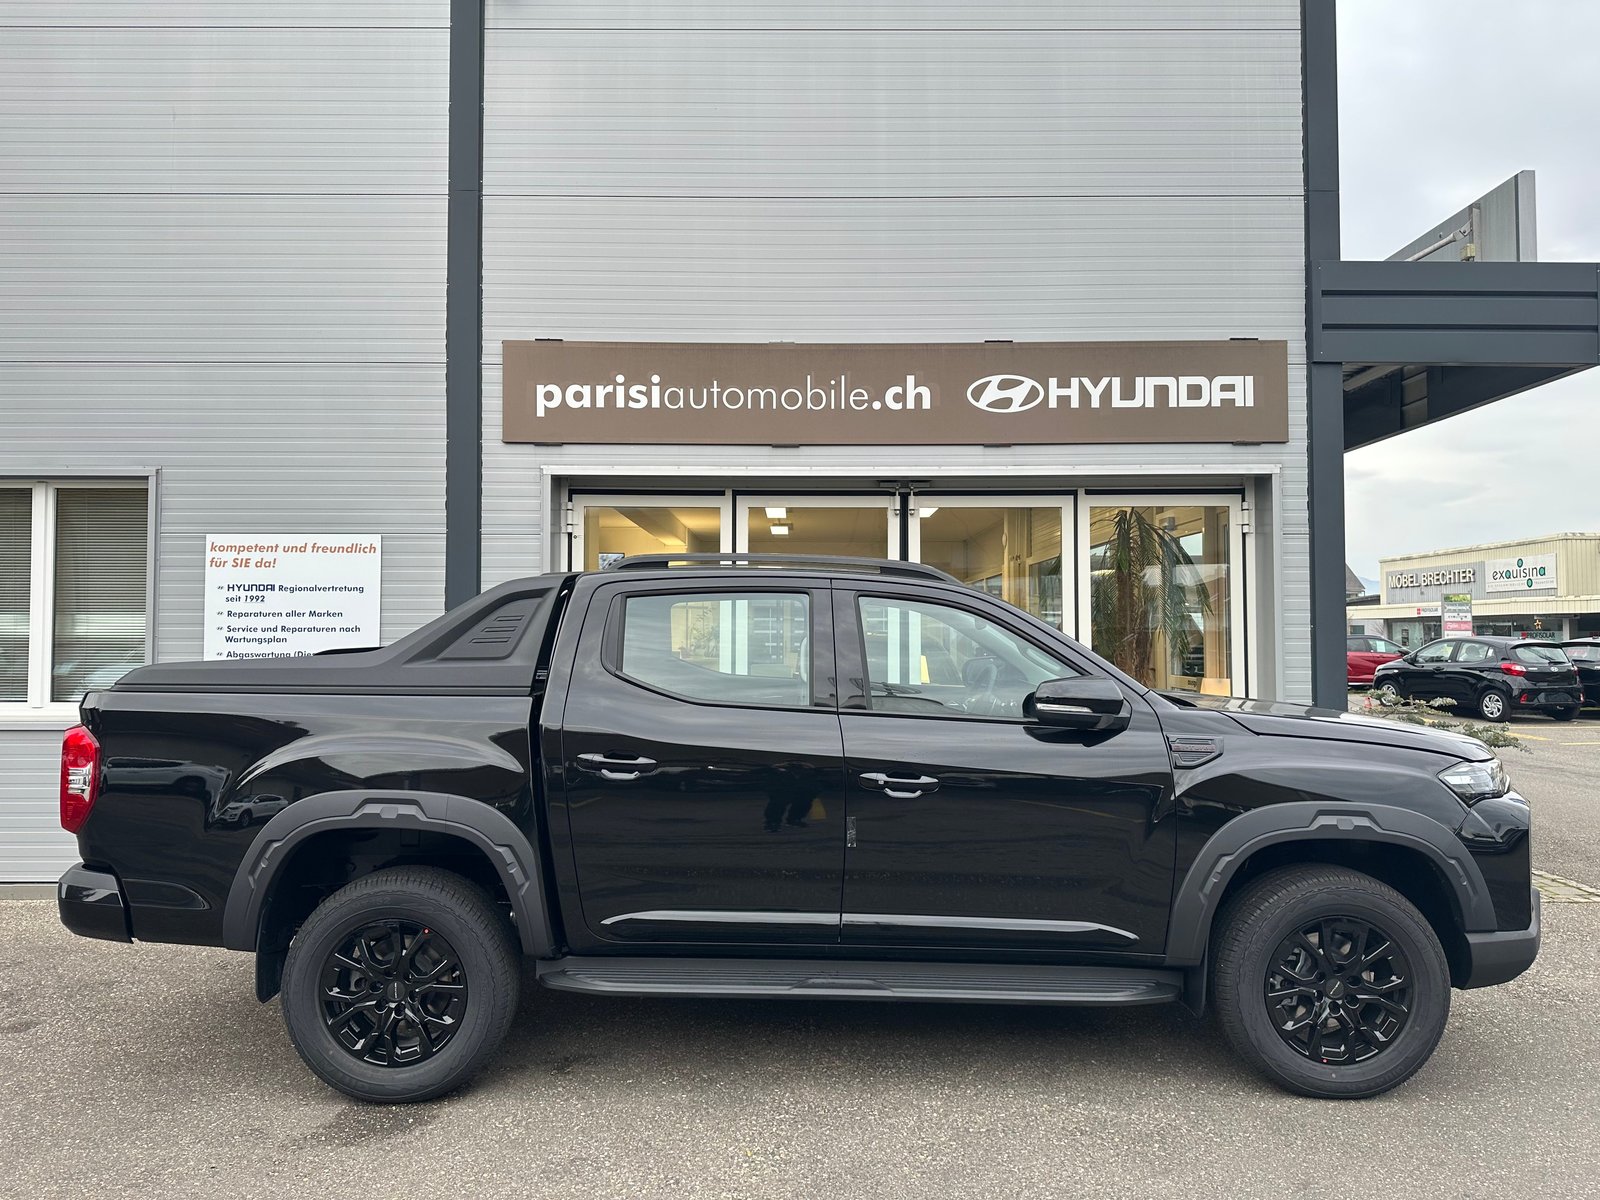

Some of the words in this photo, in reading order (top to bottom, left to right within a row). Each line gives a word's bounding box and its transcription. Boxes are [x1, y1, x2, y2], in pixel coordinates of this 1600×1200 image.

[536, 374, 931, 417] parisiautomobile.ch
[1048, 375, 1254, 409] HYUNDAI
[209, 542, 279, 554] kompetent
[282, 543, 307, 553] und
[311, 543, 377, 554] freundlich
[209, 557, 228, 568] für
[231, 557, 251, 568] SIE
[255, 557, 277, 568] da!
[1389, 572, 1420, 588] MÖBEL
[1421, 568, 1475, 586] BRECHTER
[227, 584, 275, 592] HYUNDAI
[278, 585, 364, 594] Regionalvertretung
[225, 595, 241, 603] seit
[244, 595, 265, 603] 1992
[227, 610, 283, 620] Reparaturen
[285, 610, 306, 618] aller
[308, 610, 343, 618] Marken
[226, 625, 258, 633] Service
[260, 625, 278, 633] und
[280, 625, 336, 635] Reparaturen
[339, 625, 361, 633] nach
[225, 636, 288, 645] Wartungsplan
